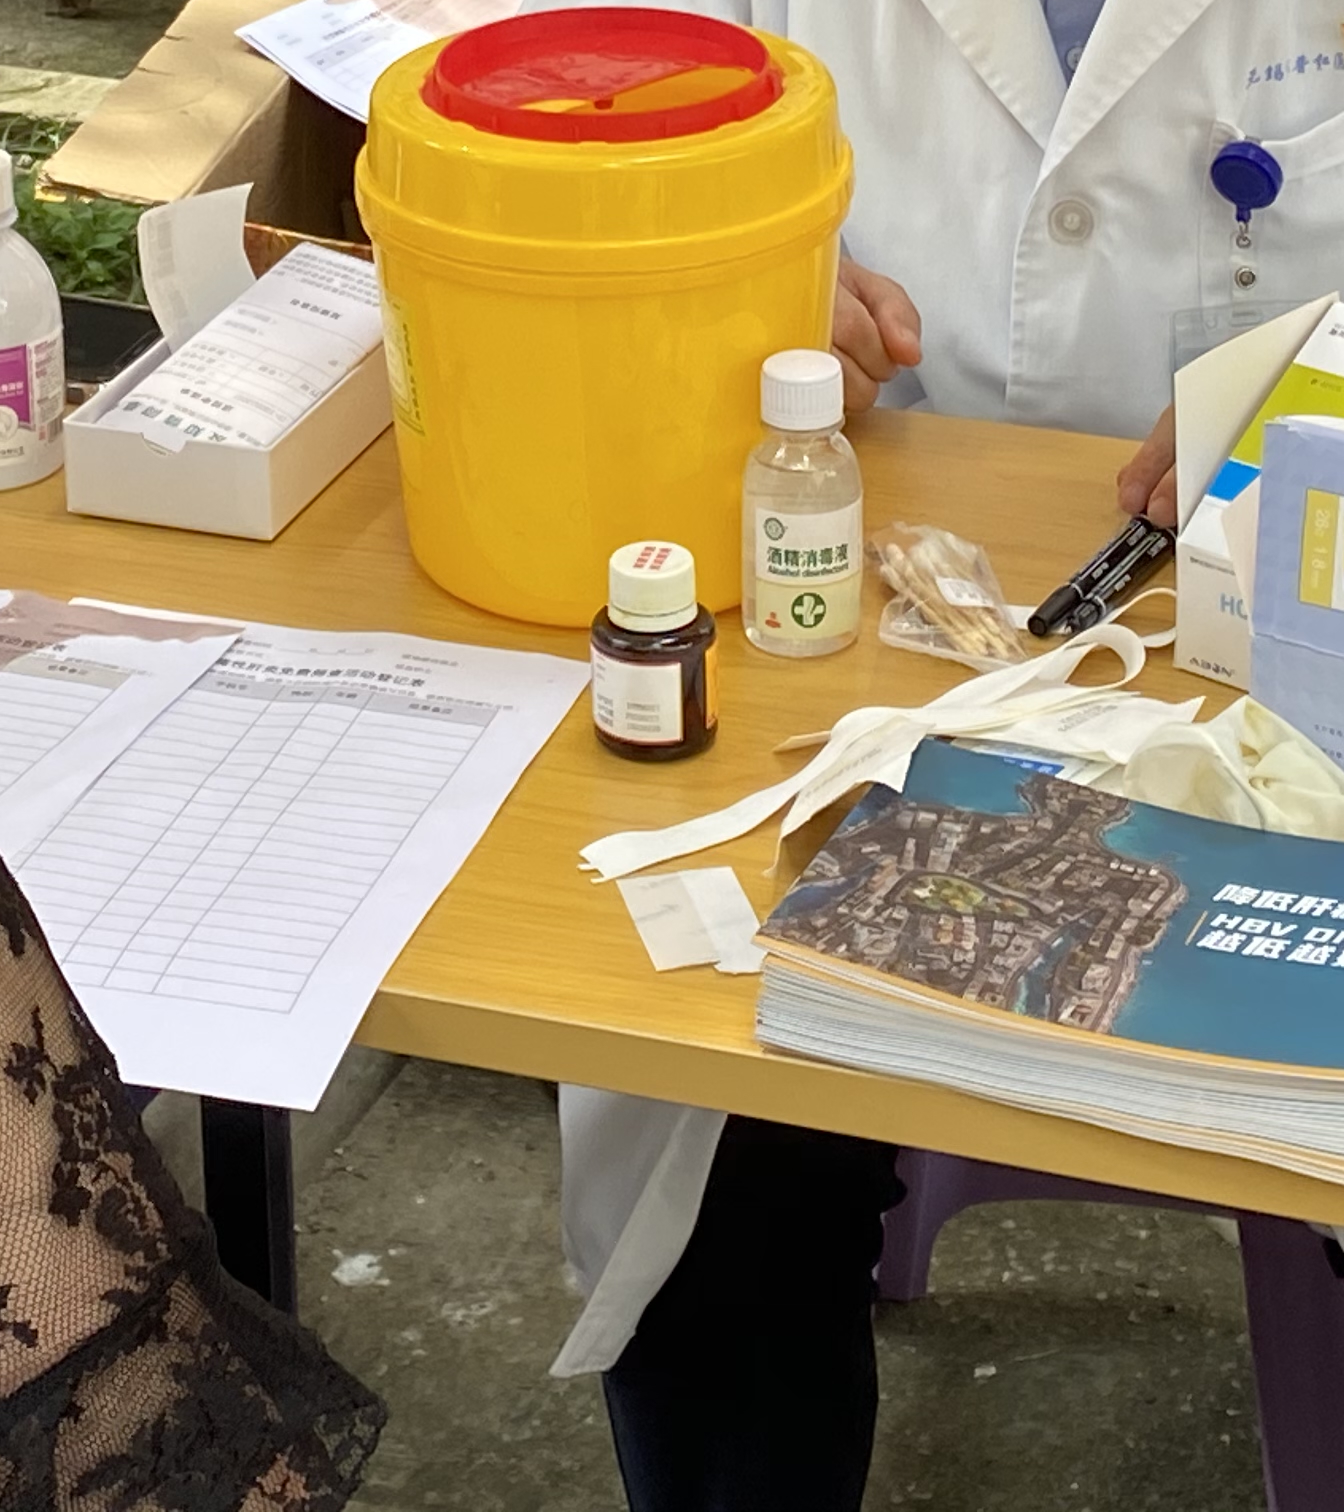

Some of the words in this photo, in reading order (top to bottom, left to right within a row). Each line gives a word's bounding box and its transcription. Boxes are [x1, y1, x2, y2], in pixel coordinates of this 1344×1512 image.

[768, 544, 848, 567] 酒精消毒液
[1210, 913, 1298, 937] HBV
